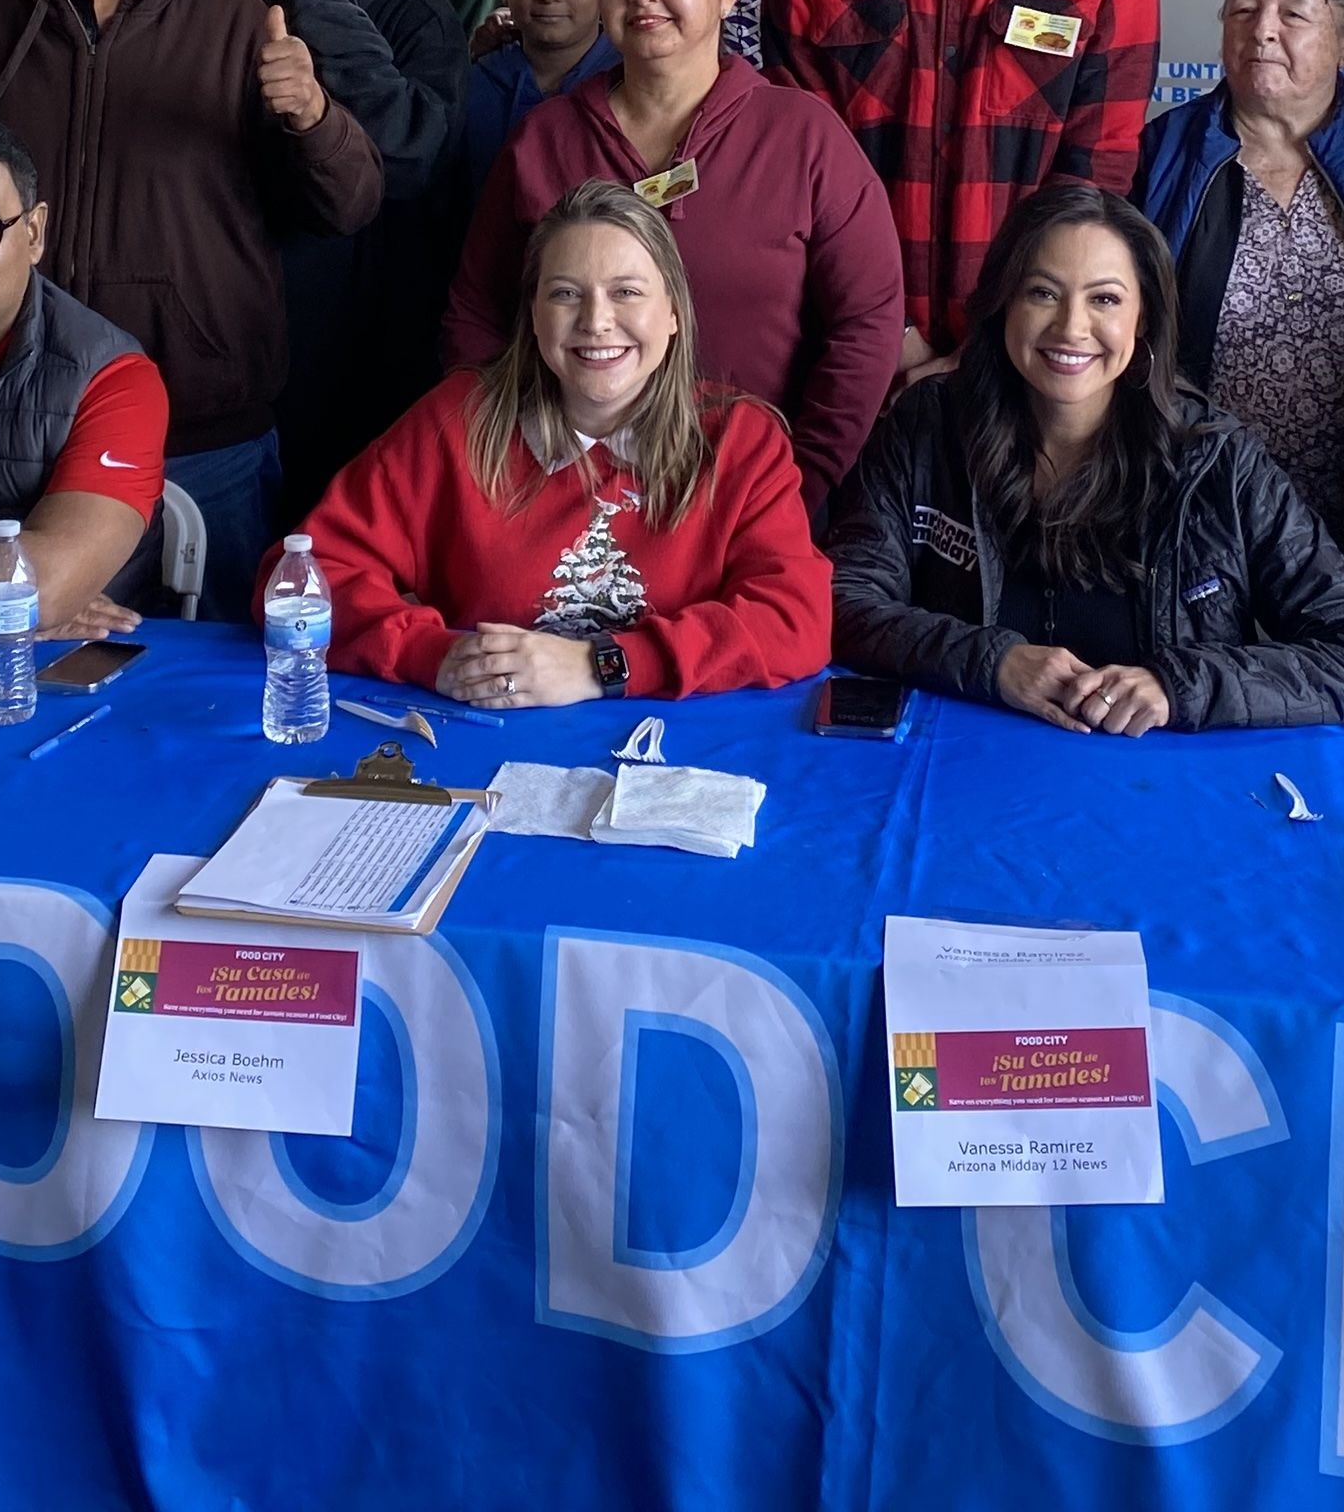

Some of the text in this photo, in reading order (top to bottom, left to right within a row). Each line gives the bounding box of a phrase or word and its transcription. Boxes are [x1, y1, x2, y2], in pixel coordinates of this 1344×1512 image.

[1169, 63, 1226, 79] UNTI
[236, 950, 285, 962] FOOD CITY
[941, 946, 1010, 957] Vanessa
[246, 966, 296, 981] Casa
[214, 983, 320, 1002] Tamales!
[1015, 1035, 1068, 1046] FOOD CITY
[173, 1049, 284, 1069] Jessica Boehm
[1031, 1050, 1083, 1067] Casa
[1084, 1053, 1098, 1062] de
[191, 1069, 263, 1085] Axios News
[980, 1065, 1110, 1092] los Tamales!
[958, 1140, 1094, 1155] Vanessa Ramirez
[948, 1159, 1108, 1173] Arizona Midday 12 News
